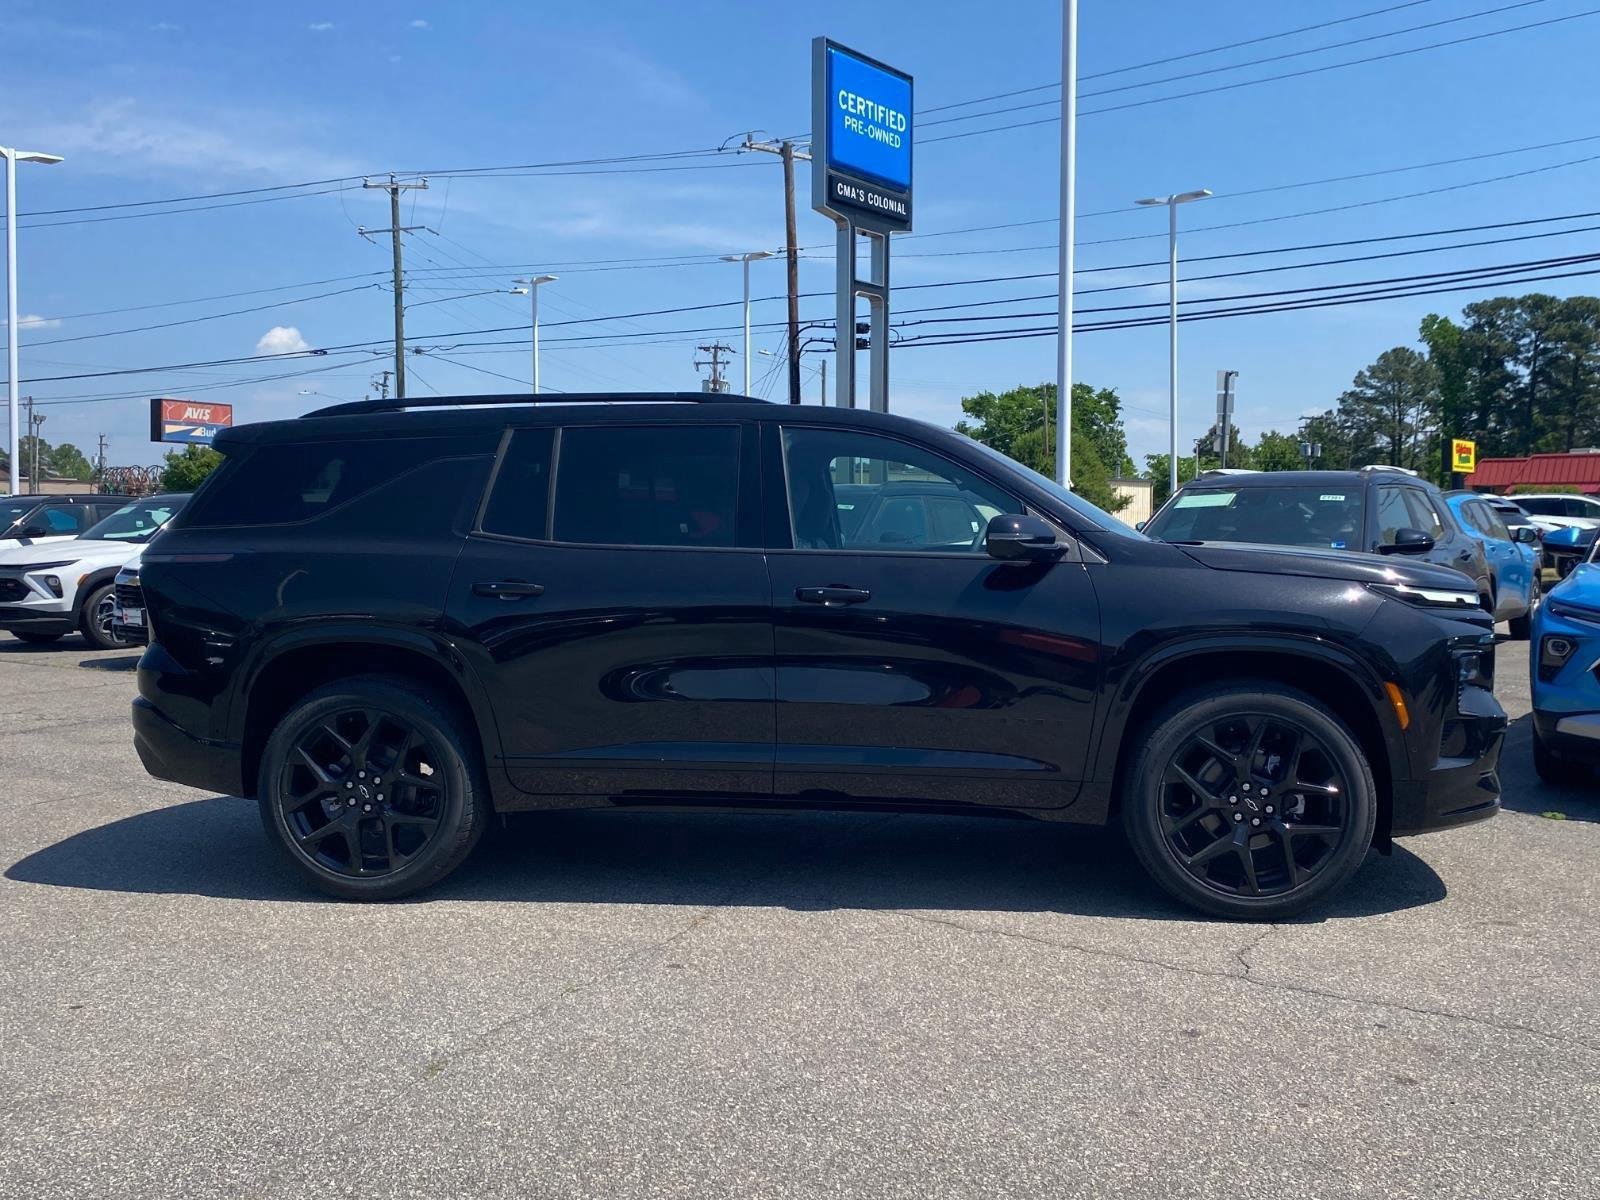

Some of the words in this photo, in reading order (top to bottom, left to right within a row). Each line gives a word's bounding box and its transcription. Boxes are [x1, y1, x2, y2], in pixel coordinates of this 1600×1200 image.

[838, 89, 906, 132] CERTIFIED
[844, 115, 901, 148] PRE-OWNED
[837, 182, 865, 202] CMA'S
[867, 192, 907, 215] COLONIAL
[185, 406, 211, 420] AVIS
[200, 426, 217, 437] Bud
